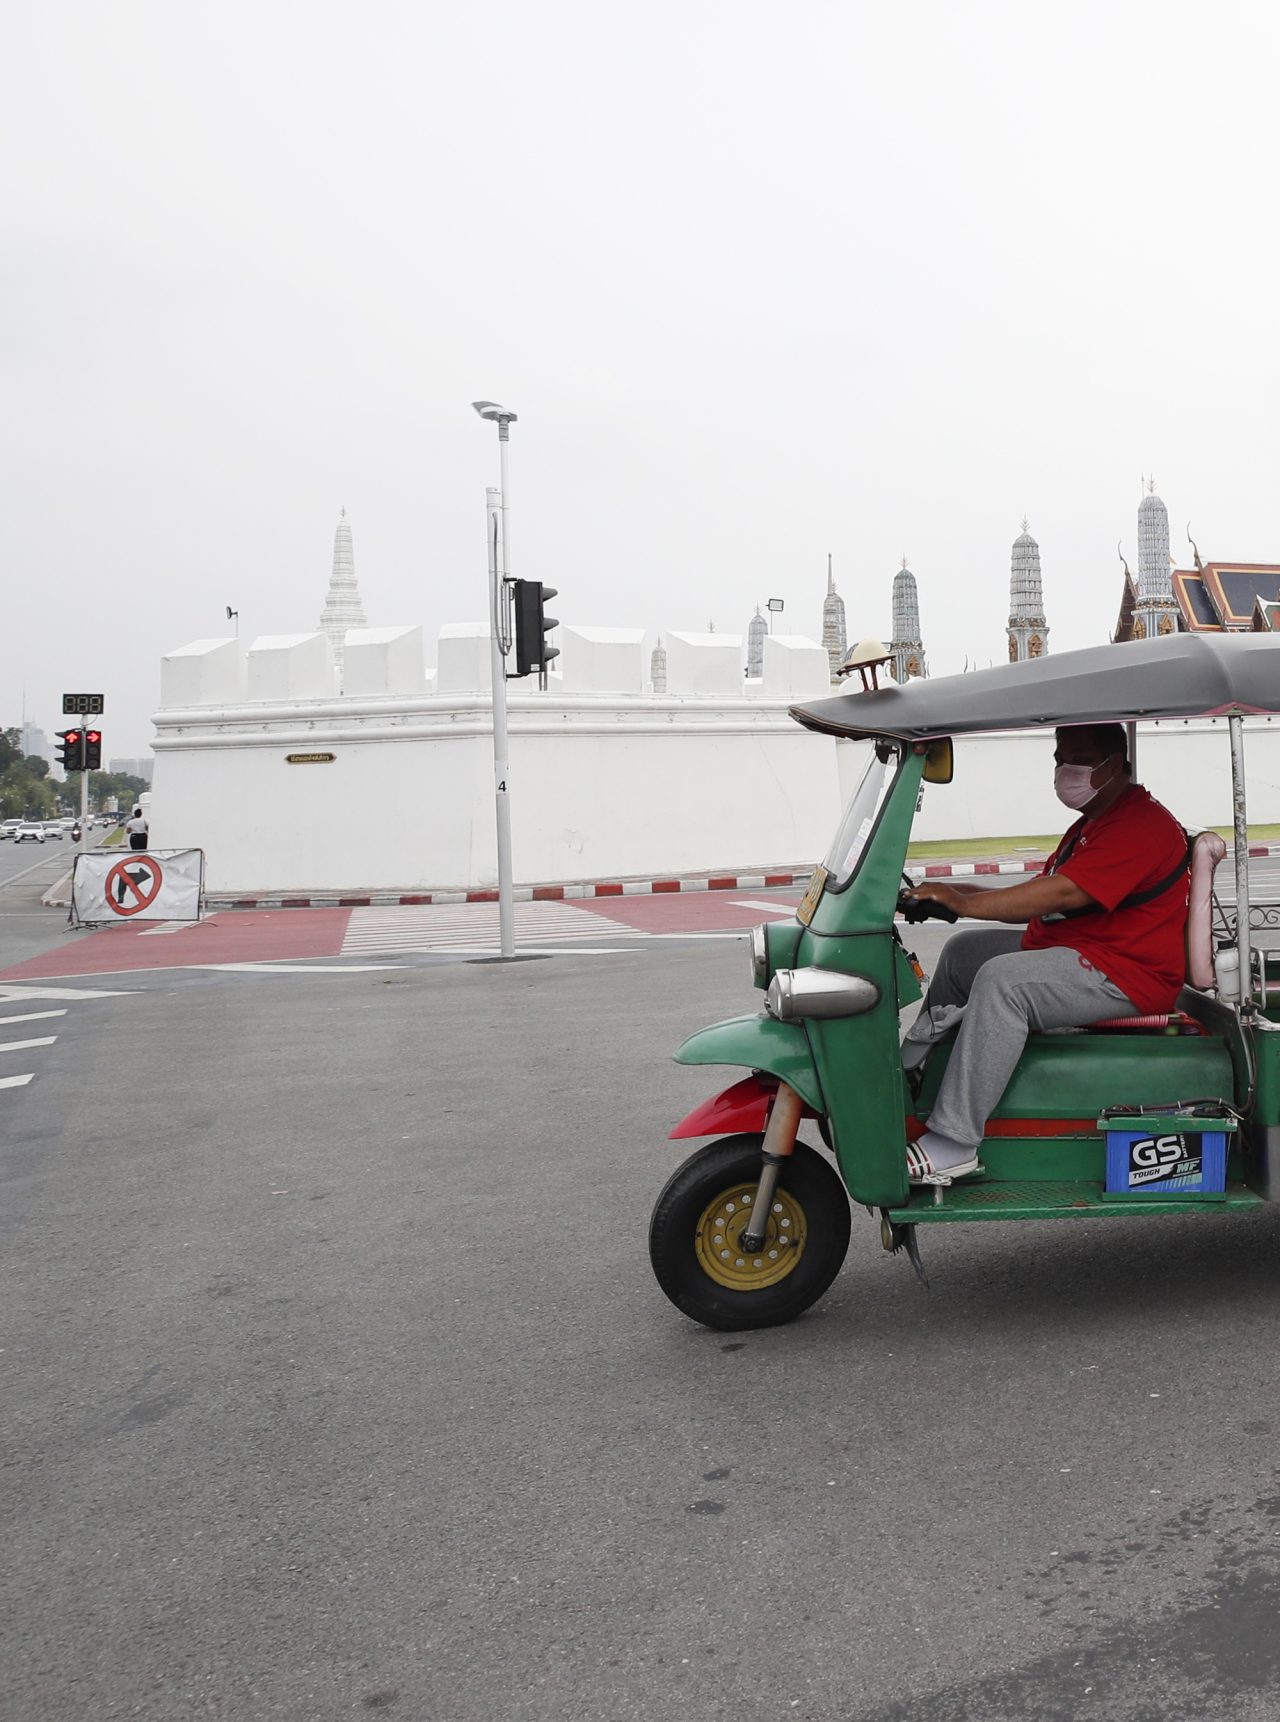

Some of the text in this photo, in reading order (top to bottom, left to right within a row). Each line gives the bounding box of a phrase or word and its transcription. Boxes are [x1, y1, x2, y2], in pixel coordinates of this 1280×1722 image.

[498, 780, 507, 792] 4
[1133, 1135, 1182, 1167] GS
[1176, 1160, 1200, 1173] MF
[1133, 1168, 1161, 1179] TOUGH
